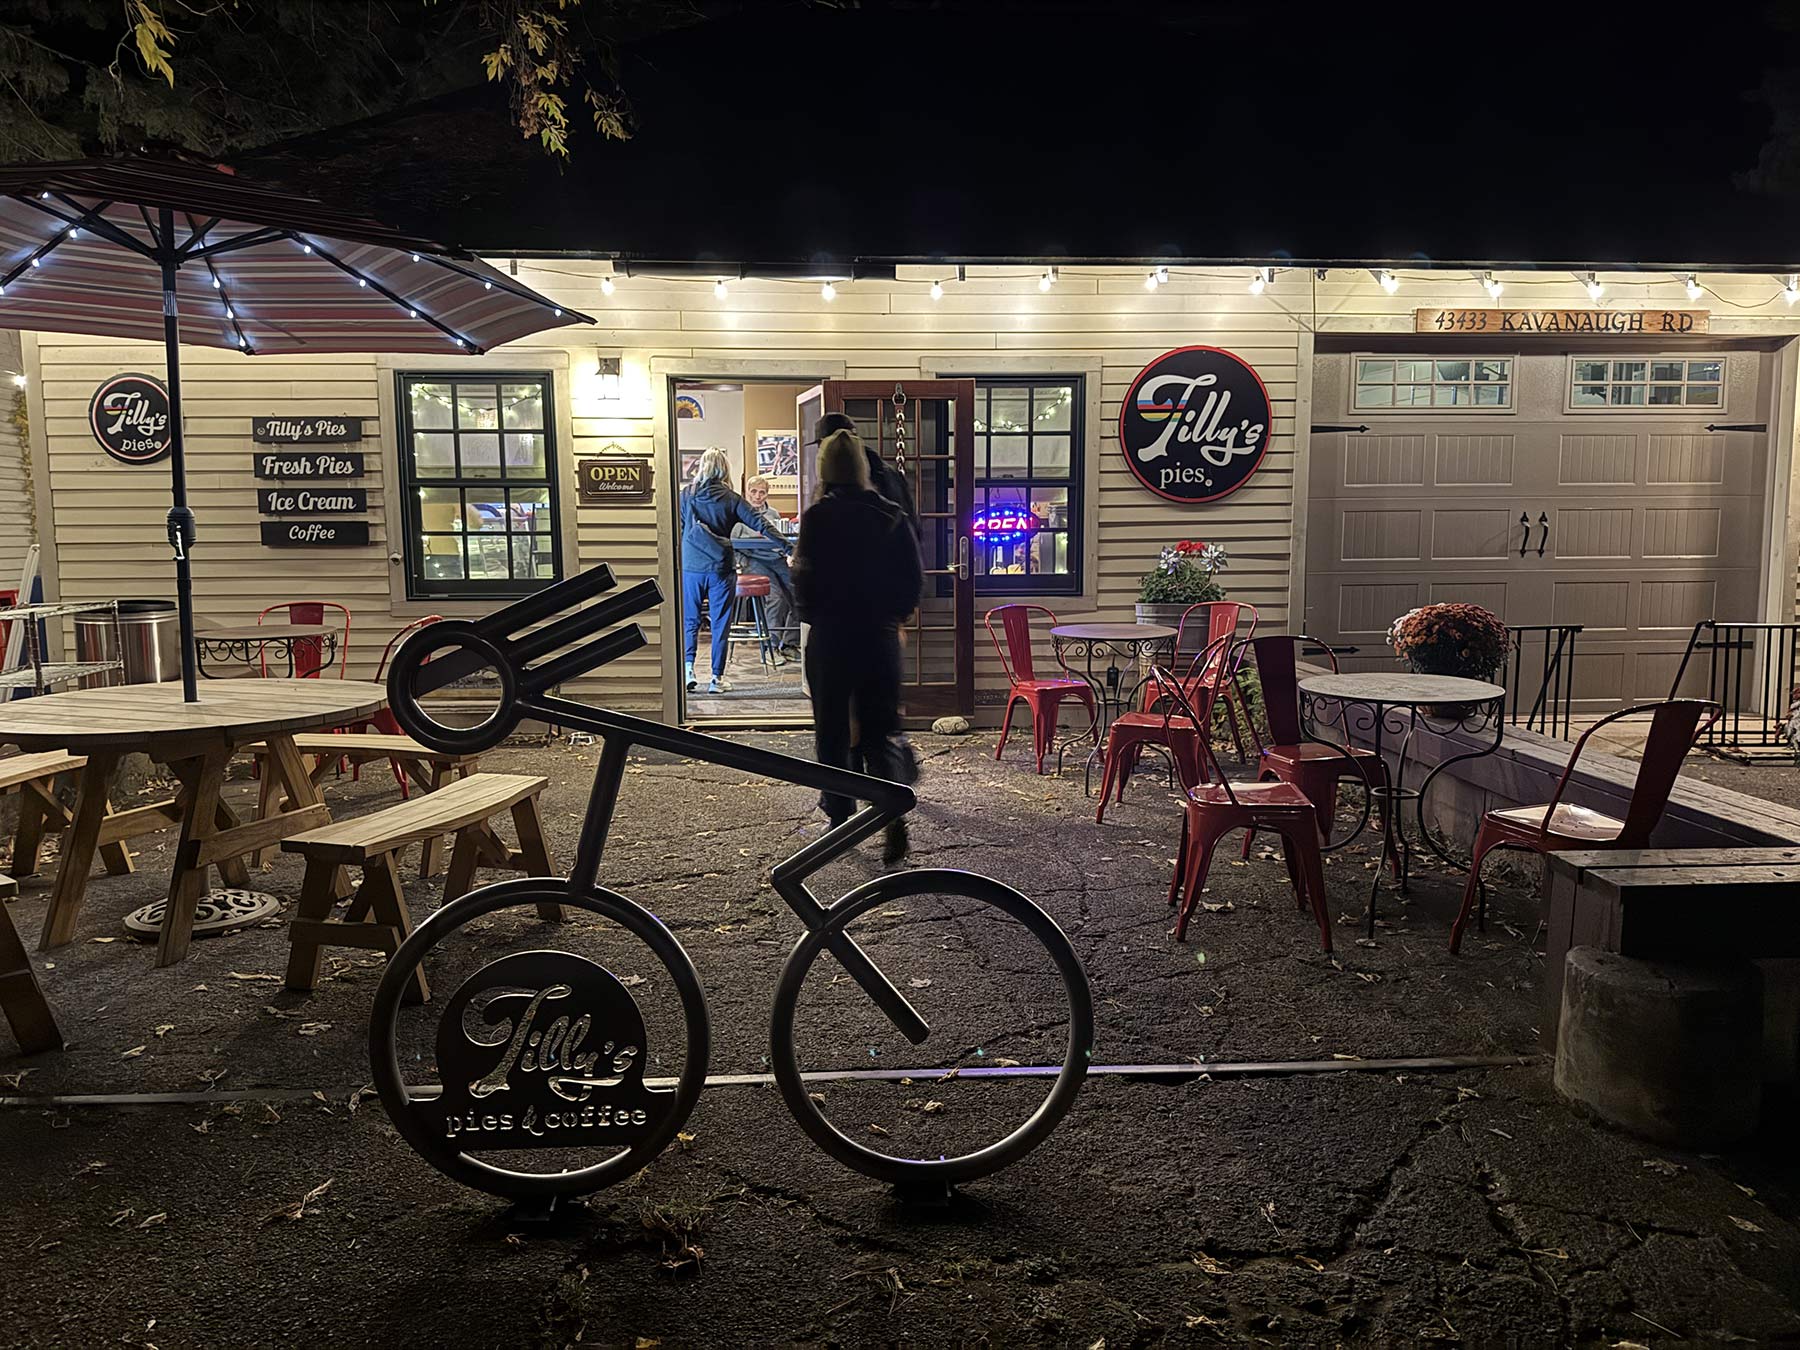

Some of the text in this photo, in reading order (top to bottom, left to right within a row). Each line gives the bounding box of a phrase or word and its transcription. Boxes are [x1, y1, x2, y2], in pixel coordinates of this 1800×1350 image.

[1434, 312, 1694, 333] 43433 KAVANAUGH RD
[103, 392, 168, 436] Tilly's
[1136, 373, 1265, 467] Tilly's
[266, 420, 347, 440] Tilly's Pies
[262, 455, 355, 475] Fresh Pies
[590, 467, 641, 481] OPEN
[599, 482, 634, 490] Welcome
[267, 491, 357, 511] Ice Cream
[289, 524, 336, 541] Coffee
[461, 984, 638, 1101] Tilly's
[446, 1104, 648, 1138] pies & coffee
